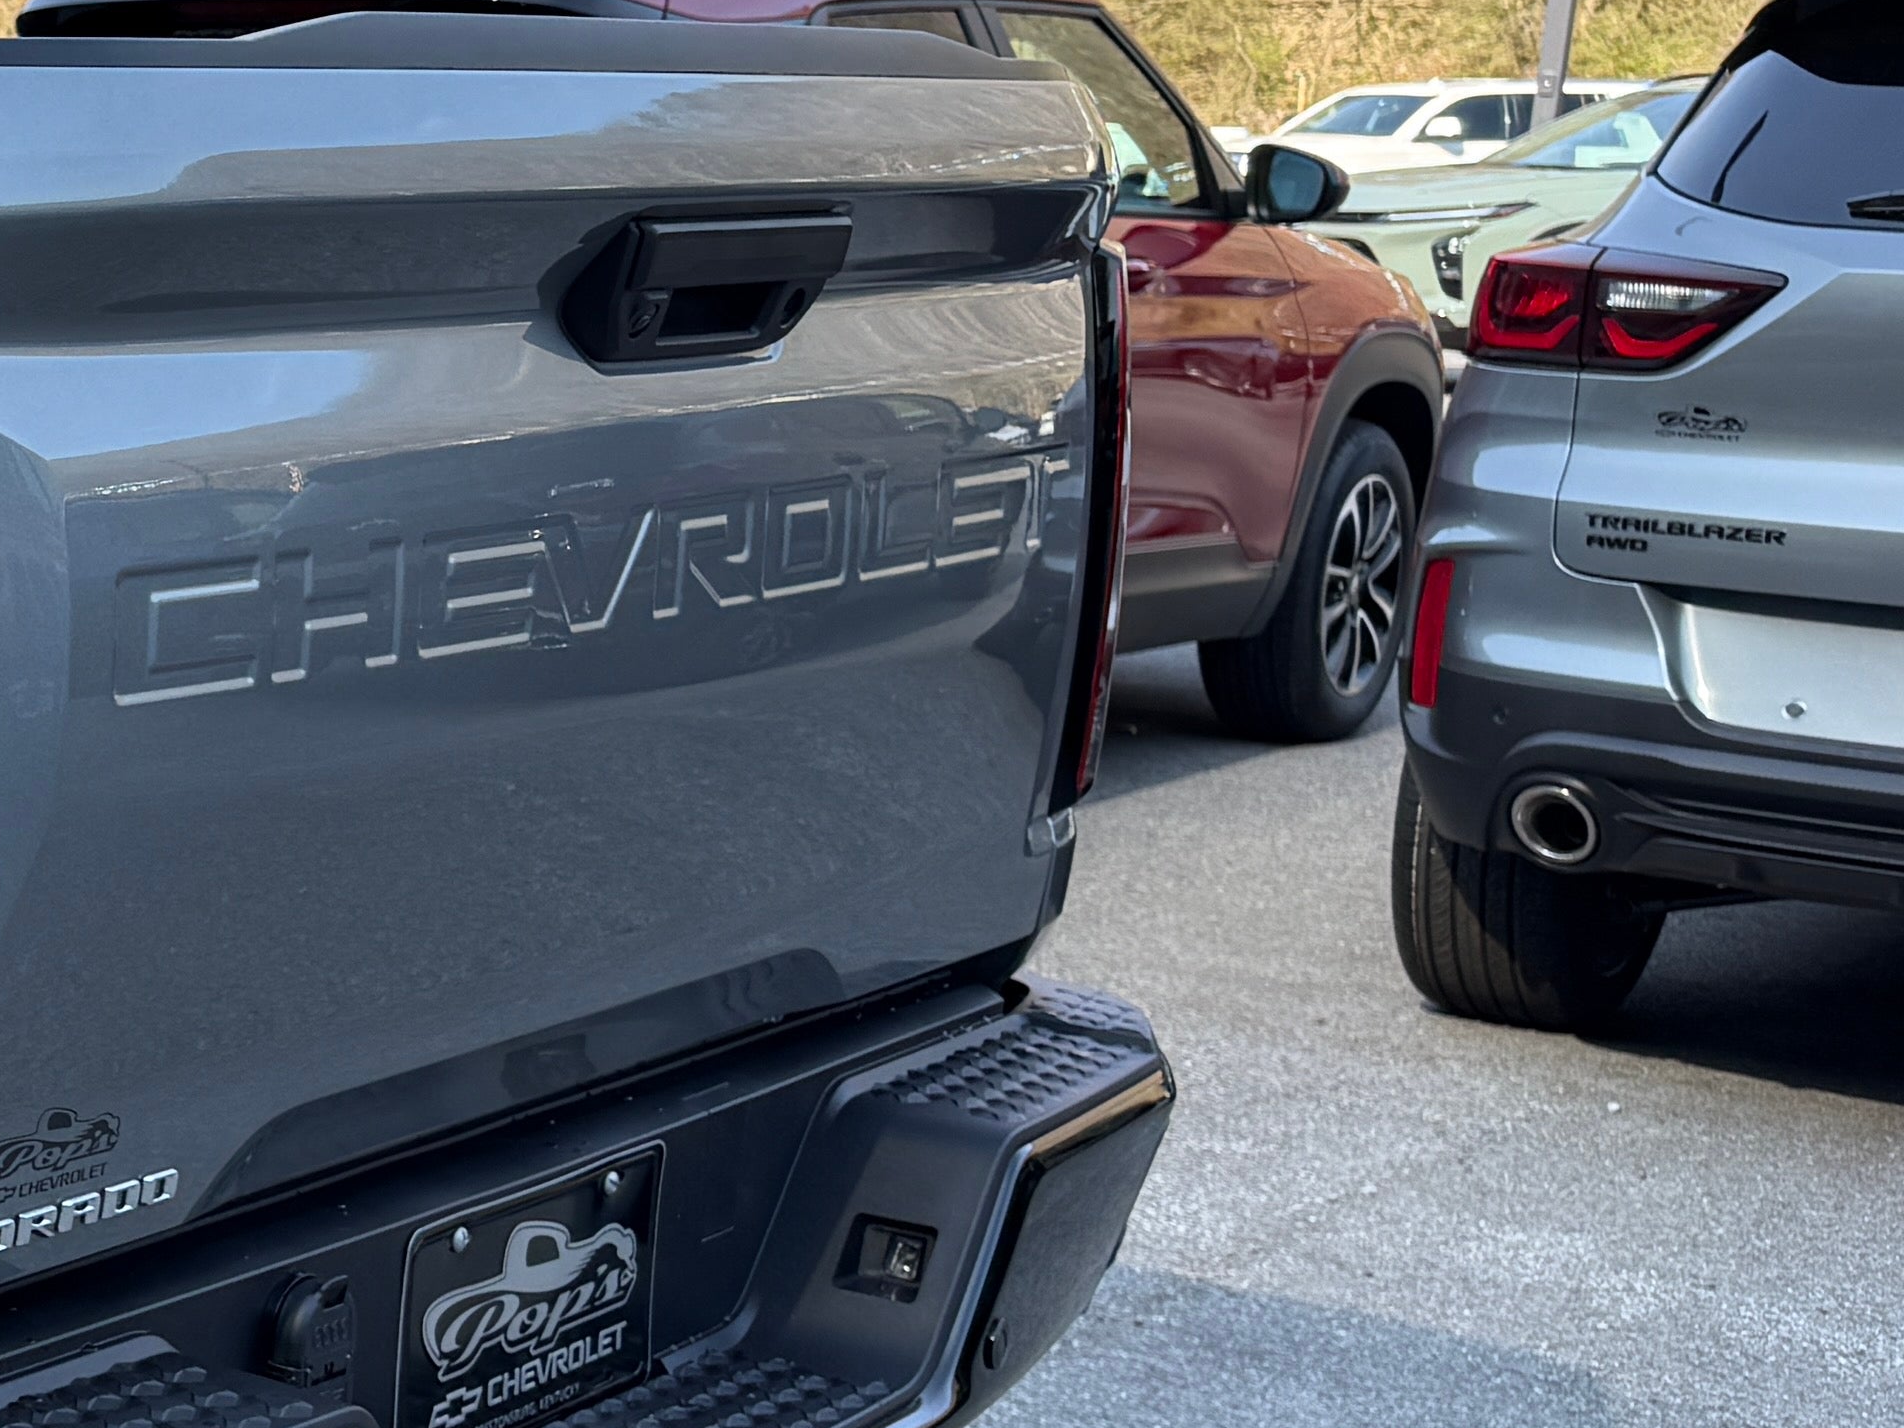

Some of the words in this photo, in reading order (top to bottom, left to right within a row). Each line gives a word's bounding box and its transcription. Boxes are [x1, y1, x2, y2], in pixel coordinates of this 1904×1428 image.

[1585, 534, 1649, 553] AWD
[1586, 512, 1787, 546] TRAILBLAZER
[110, 443, 1071, 708] CHEVROLET
[18, 1161, 108, 1198] CHEVROLET
[439, 1263, 632, 1370] Pop's
[486, 1320, 628, 1408] CHEVROLET
